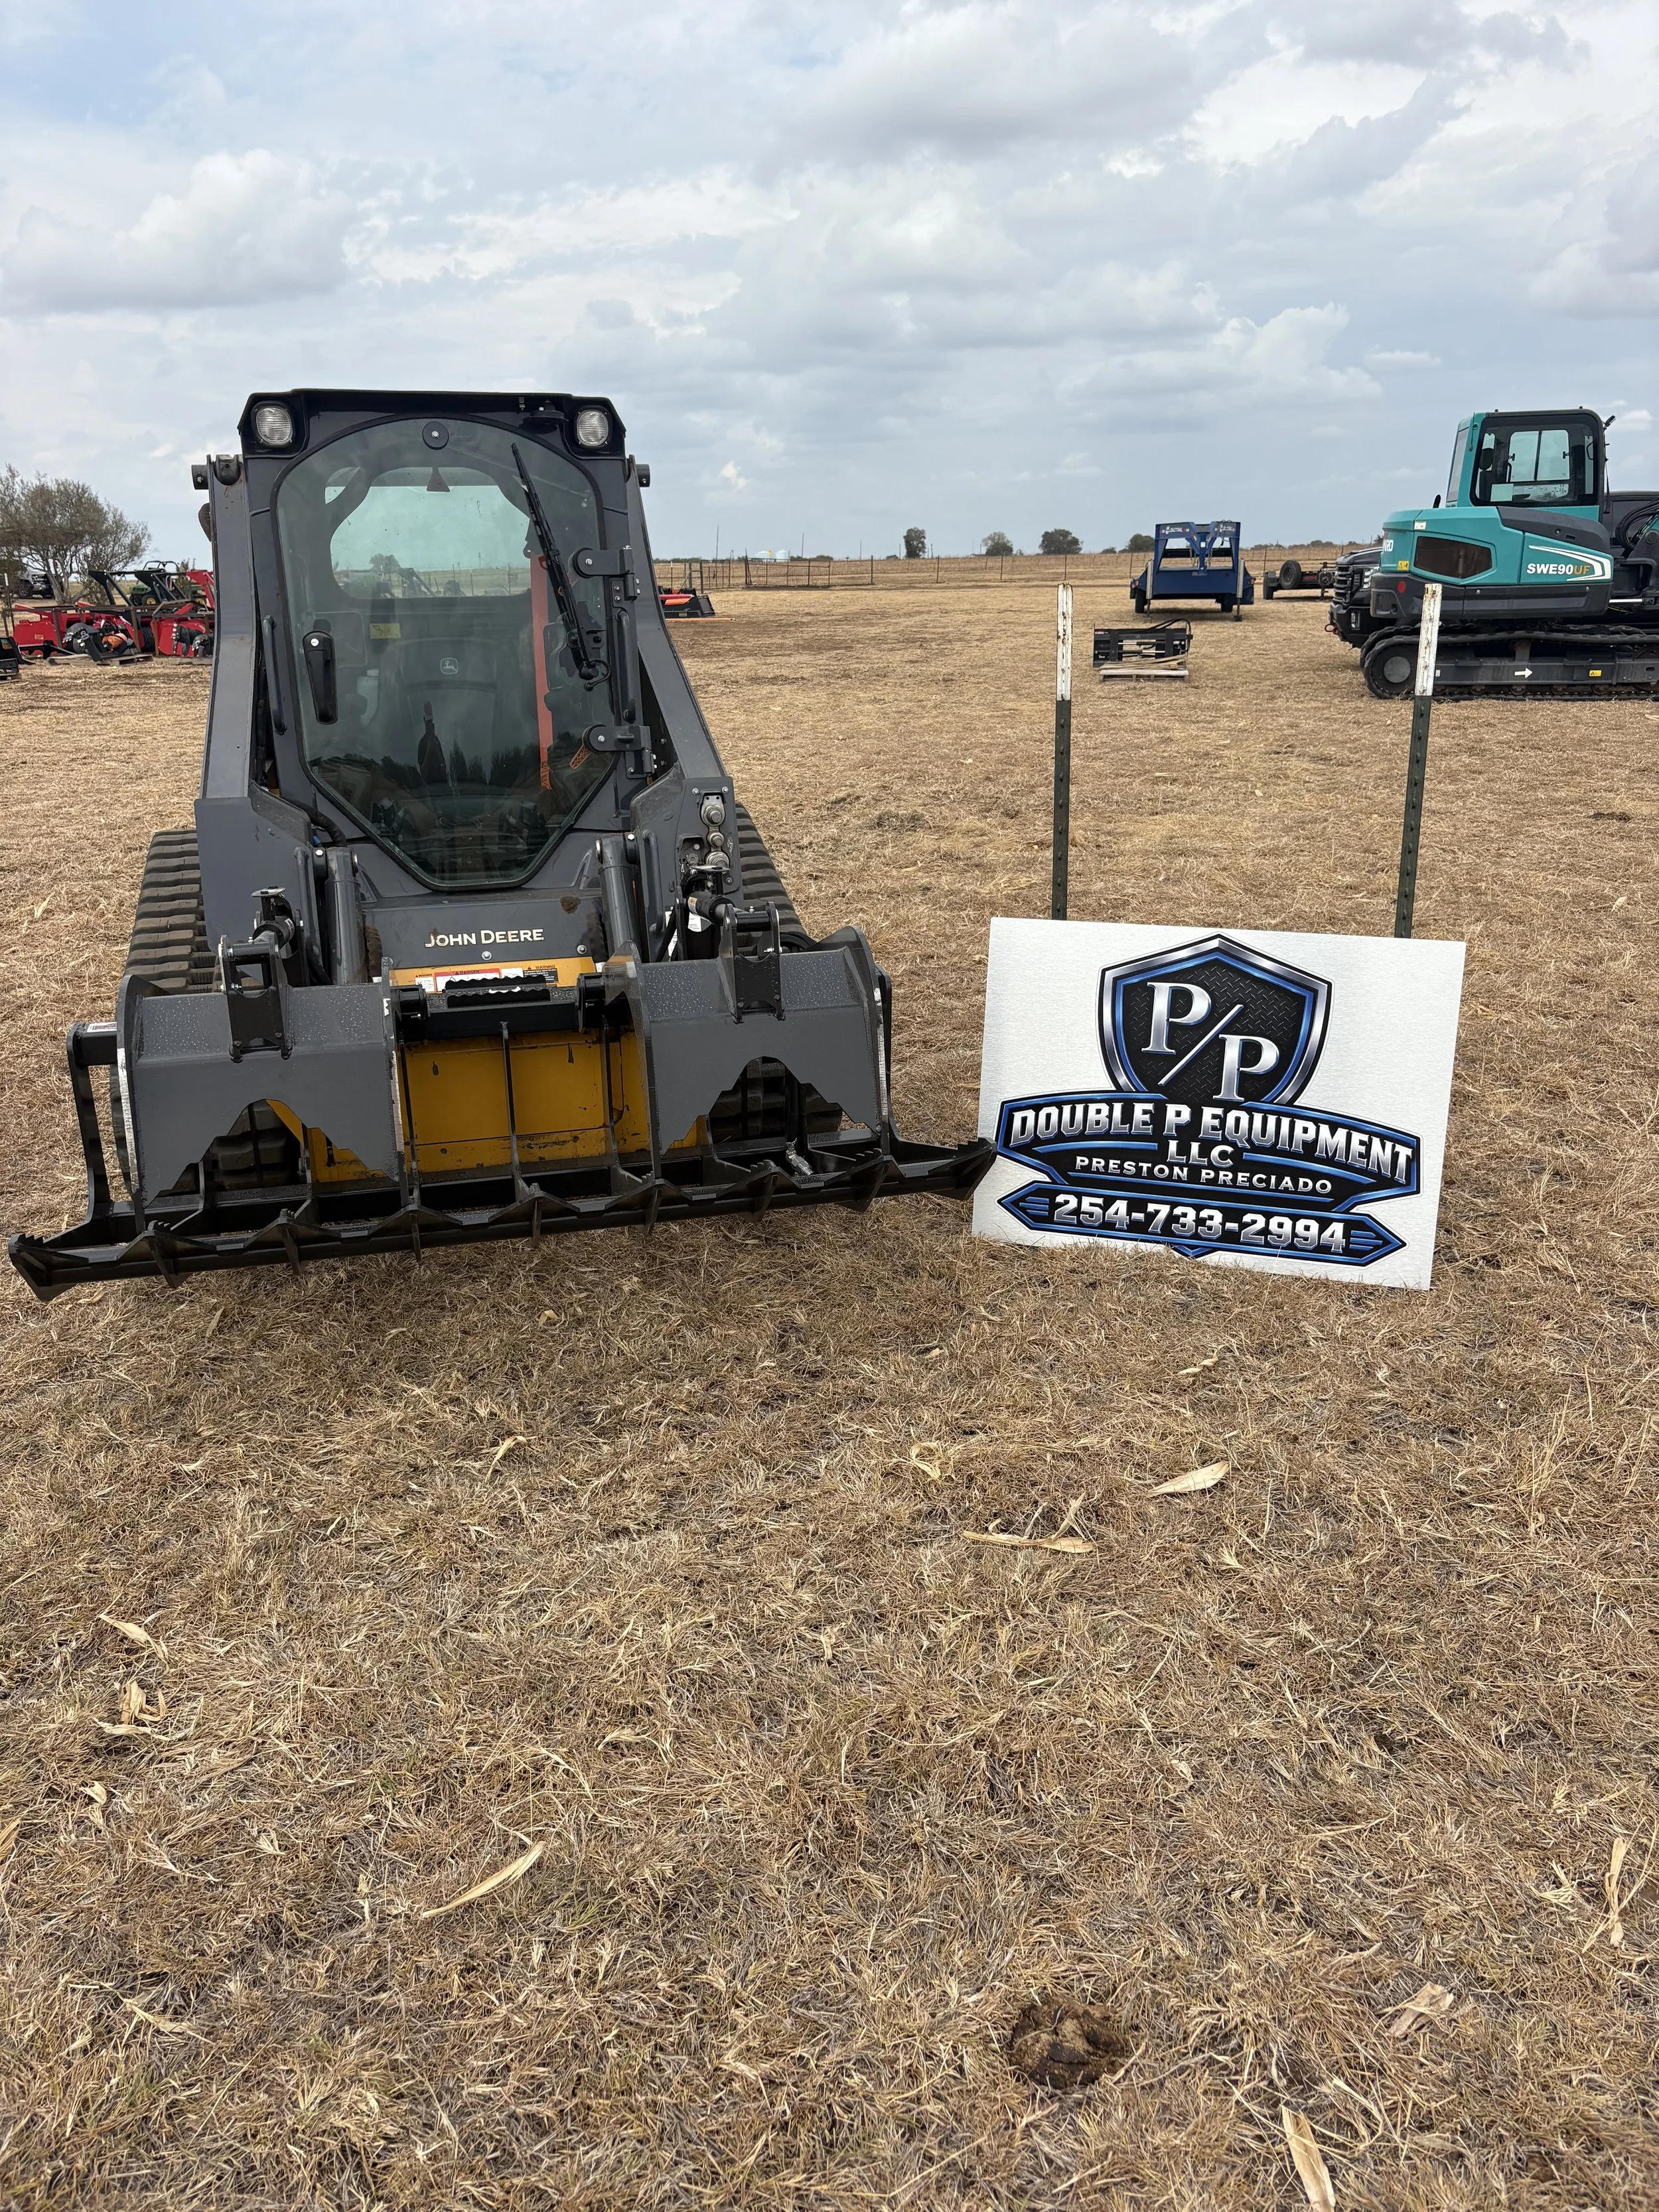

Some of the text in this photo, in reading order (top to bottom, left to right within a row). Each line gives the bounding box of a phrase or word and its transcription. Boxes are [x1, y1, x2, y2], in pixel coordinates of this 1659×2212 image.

[1527, 563, 1591, 575] SWE90UF
[425, 929, 544, 948] JOHN DEERE
[1009, 1102, 1413, 1185] DOUBLE P EQUIPMENT
[1167, 1140, 1234, 1168] LLC
[1075, 1155, 1332, 1194] PRESTON PRECIADO
[1054, 1193, 1346, 1254] 254-733-2994
